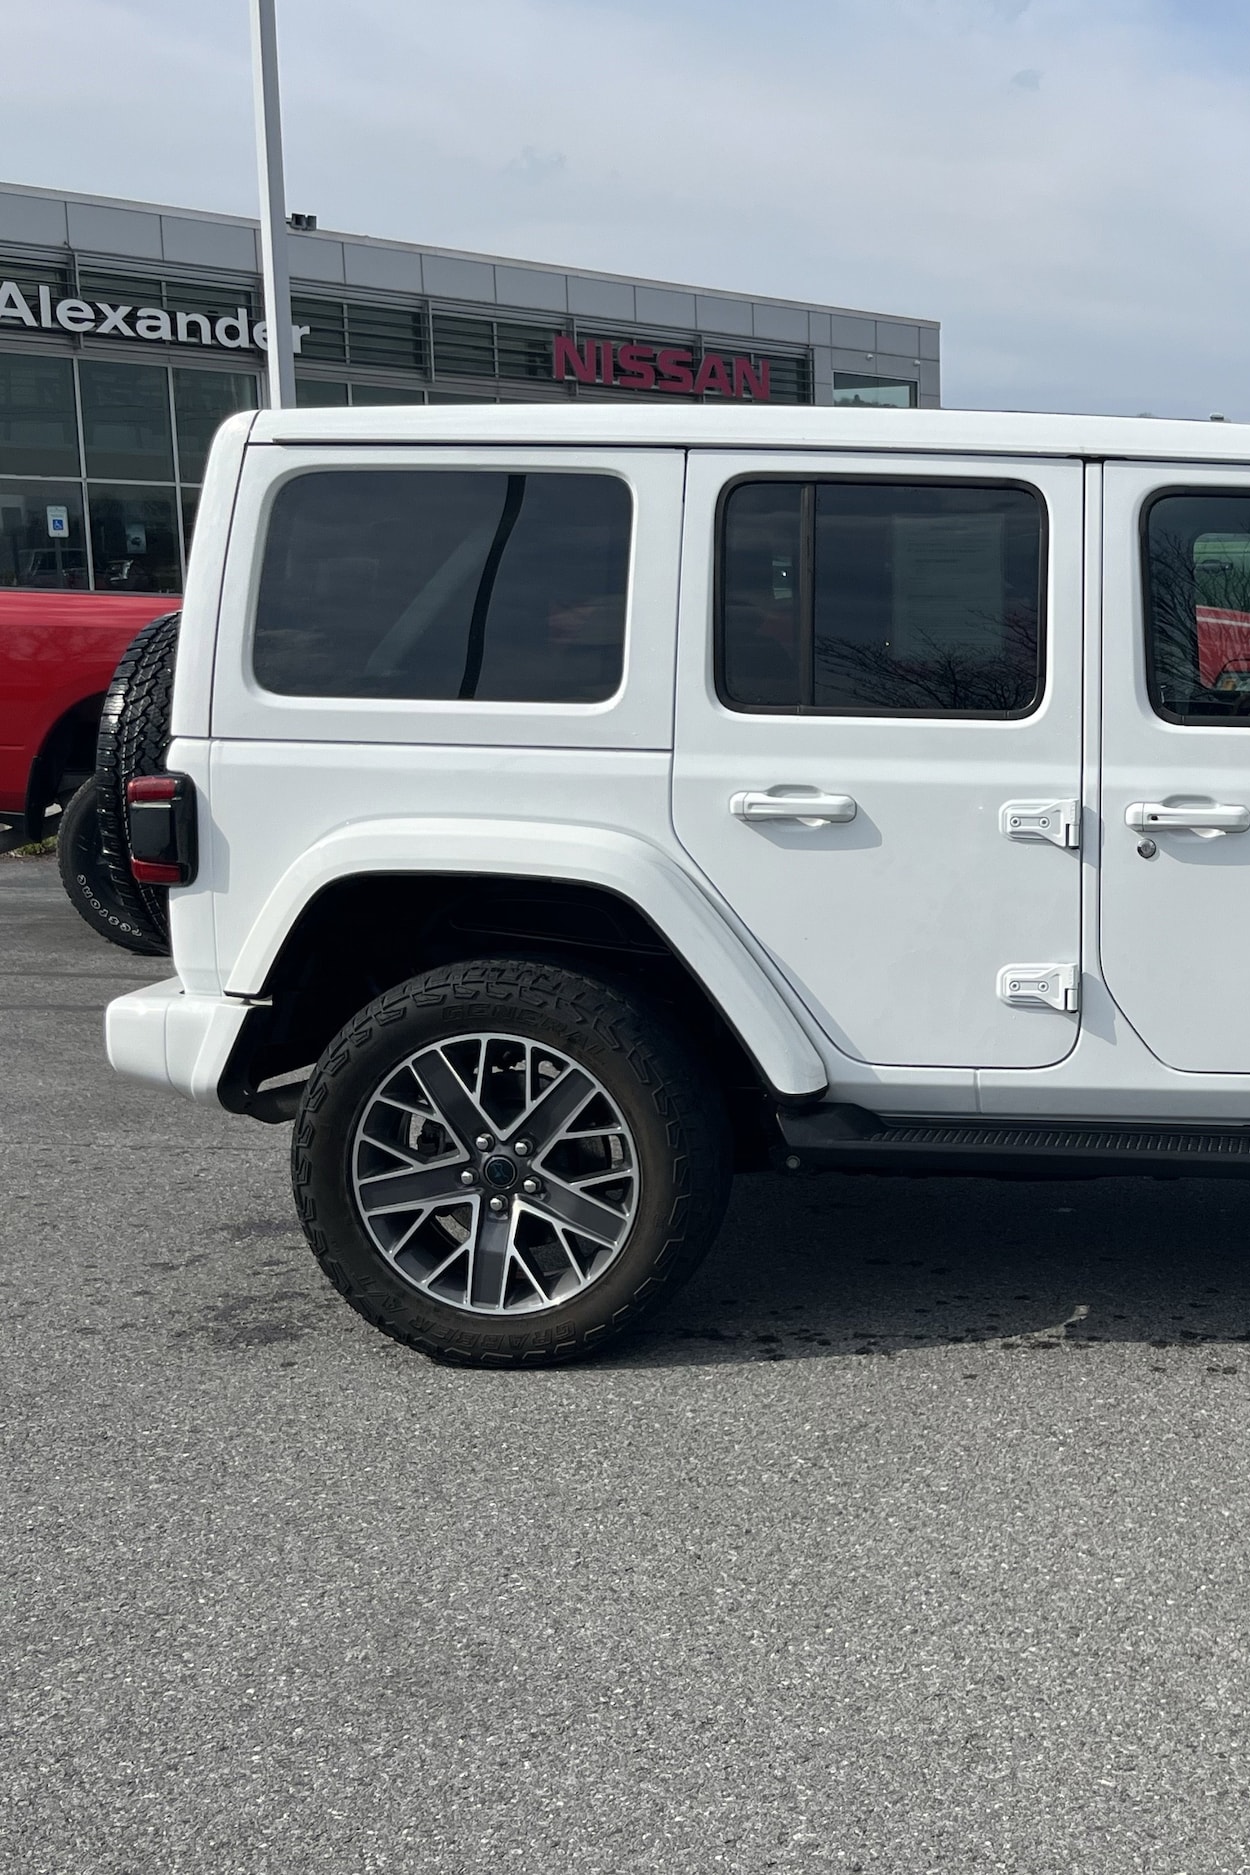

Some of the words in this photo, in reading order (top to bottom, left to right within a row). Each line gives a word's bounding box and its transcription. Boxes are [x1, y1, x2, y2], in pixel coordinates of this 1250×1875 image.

[553, 335, 771, 400] NISSAN
[76, 874, 142, 937] restone
[442, 1002, 606, 1056] GENERAL
[407, 1314, 577, 1350] GRABBER
